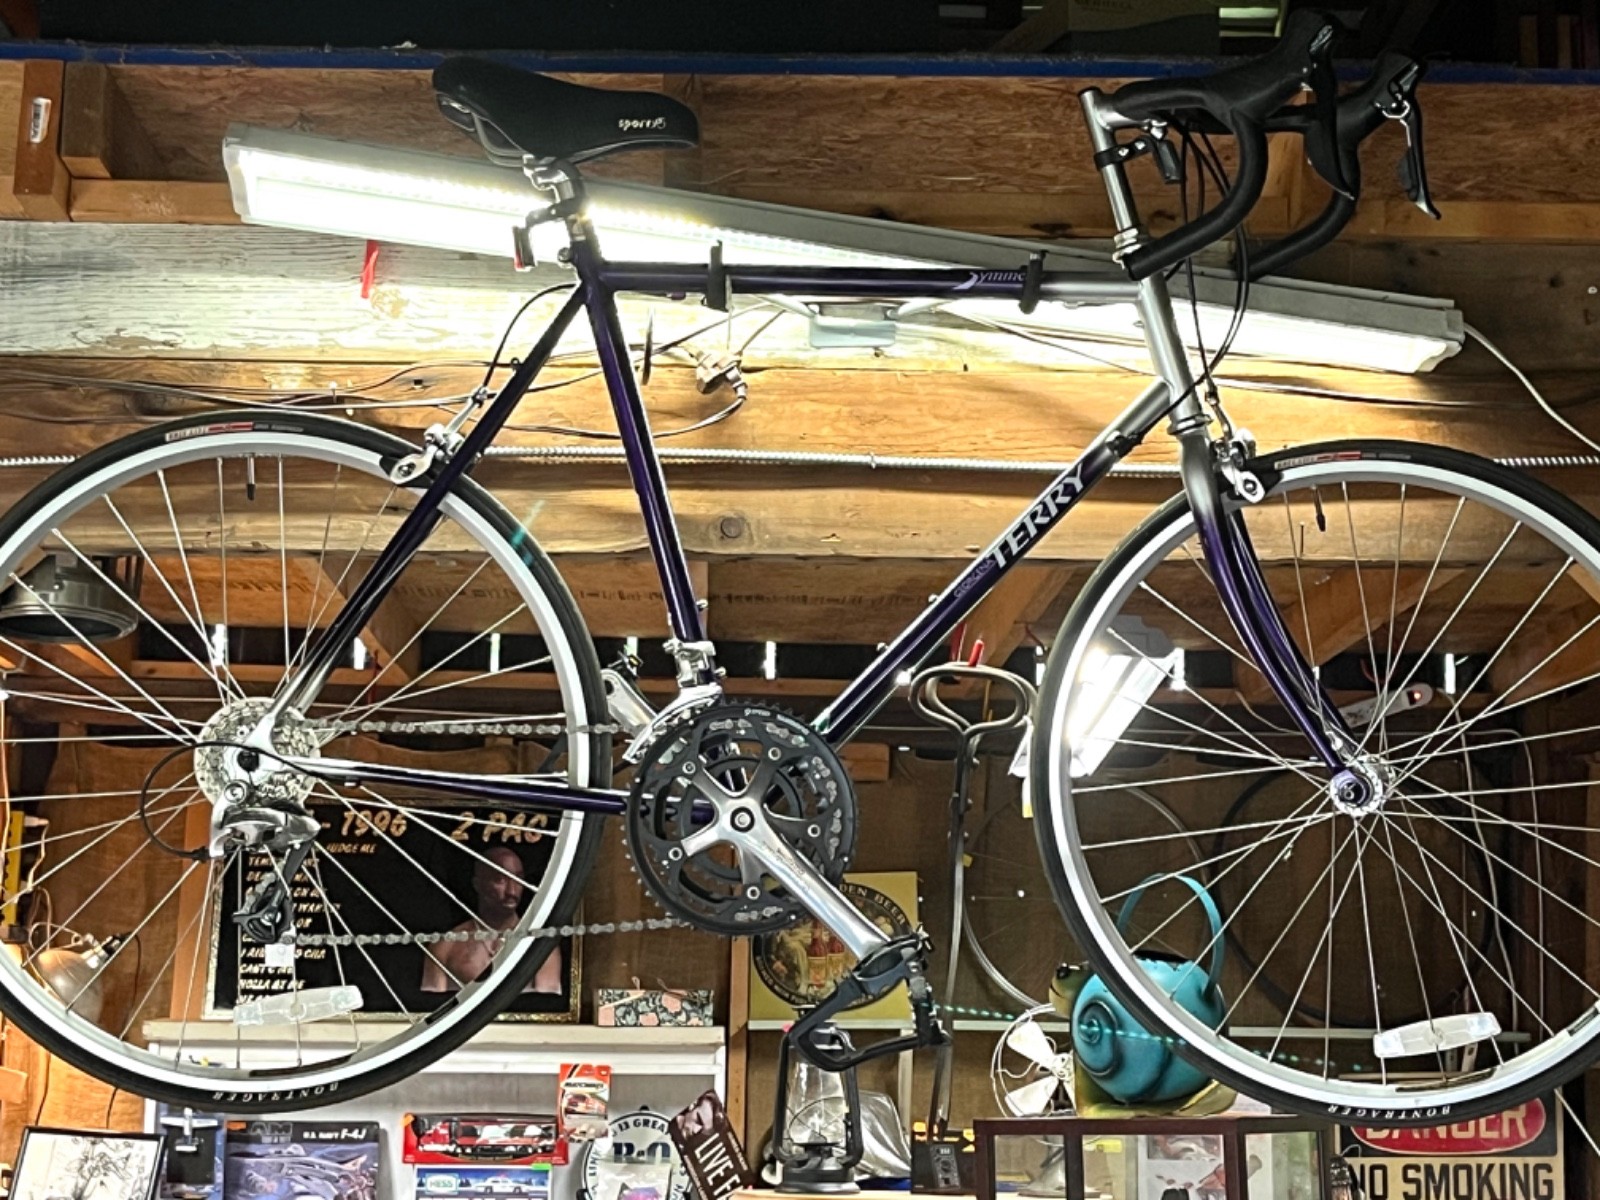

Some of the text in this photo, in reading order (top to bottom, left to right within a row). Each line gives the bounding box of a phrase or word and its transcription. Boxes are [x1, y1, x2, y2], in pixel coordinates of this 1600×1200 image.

[991, 462, 1084, 568] TERRY
[341, 810, 408, 837] 1996
[450, 811, 549, 843] 2 PAC
[212, 1081, 339, 1102] BONTRAGER
[1327, 1104, 1451, 1120] BONTRAGER
[694, 1132, 734, 1186] LIVE
[1402, 1163, 1554, 1200] SMOKING
